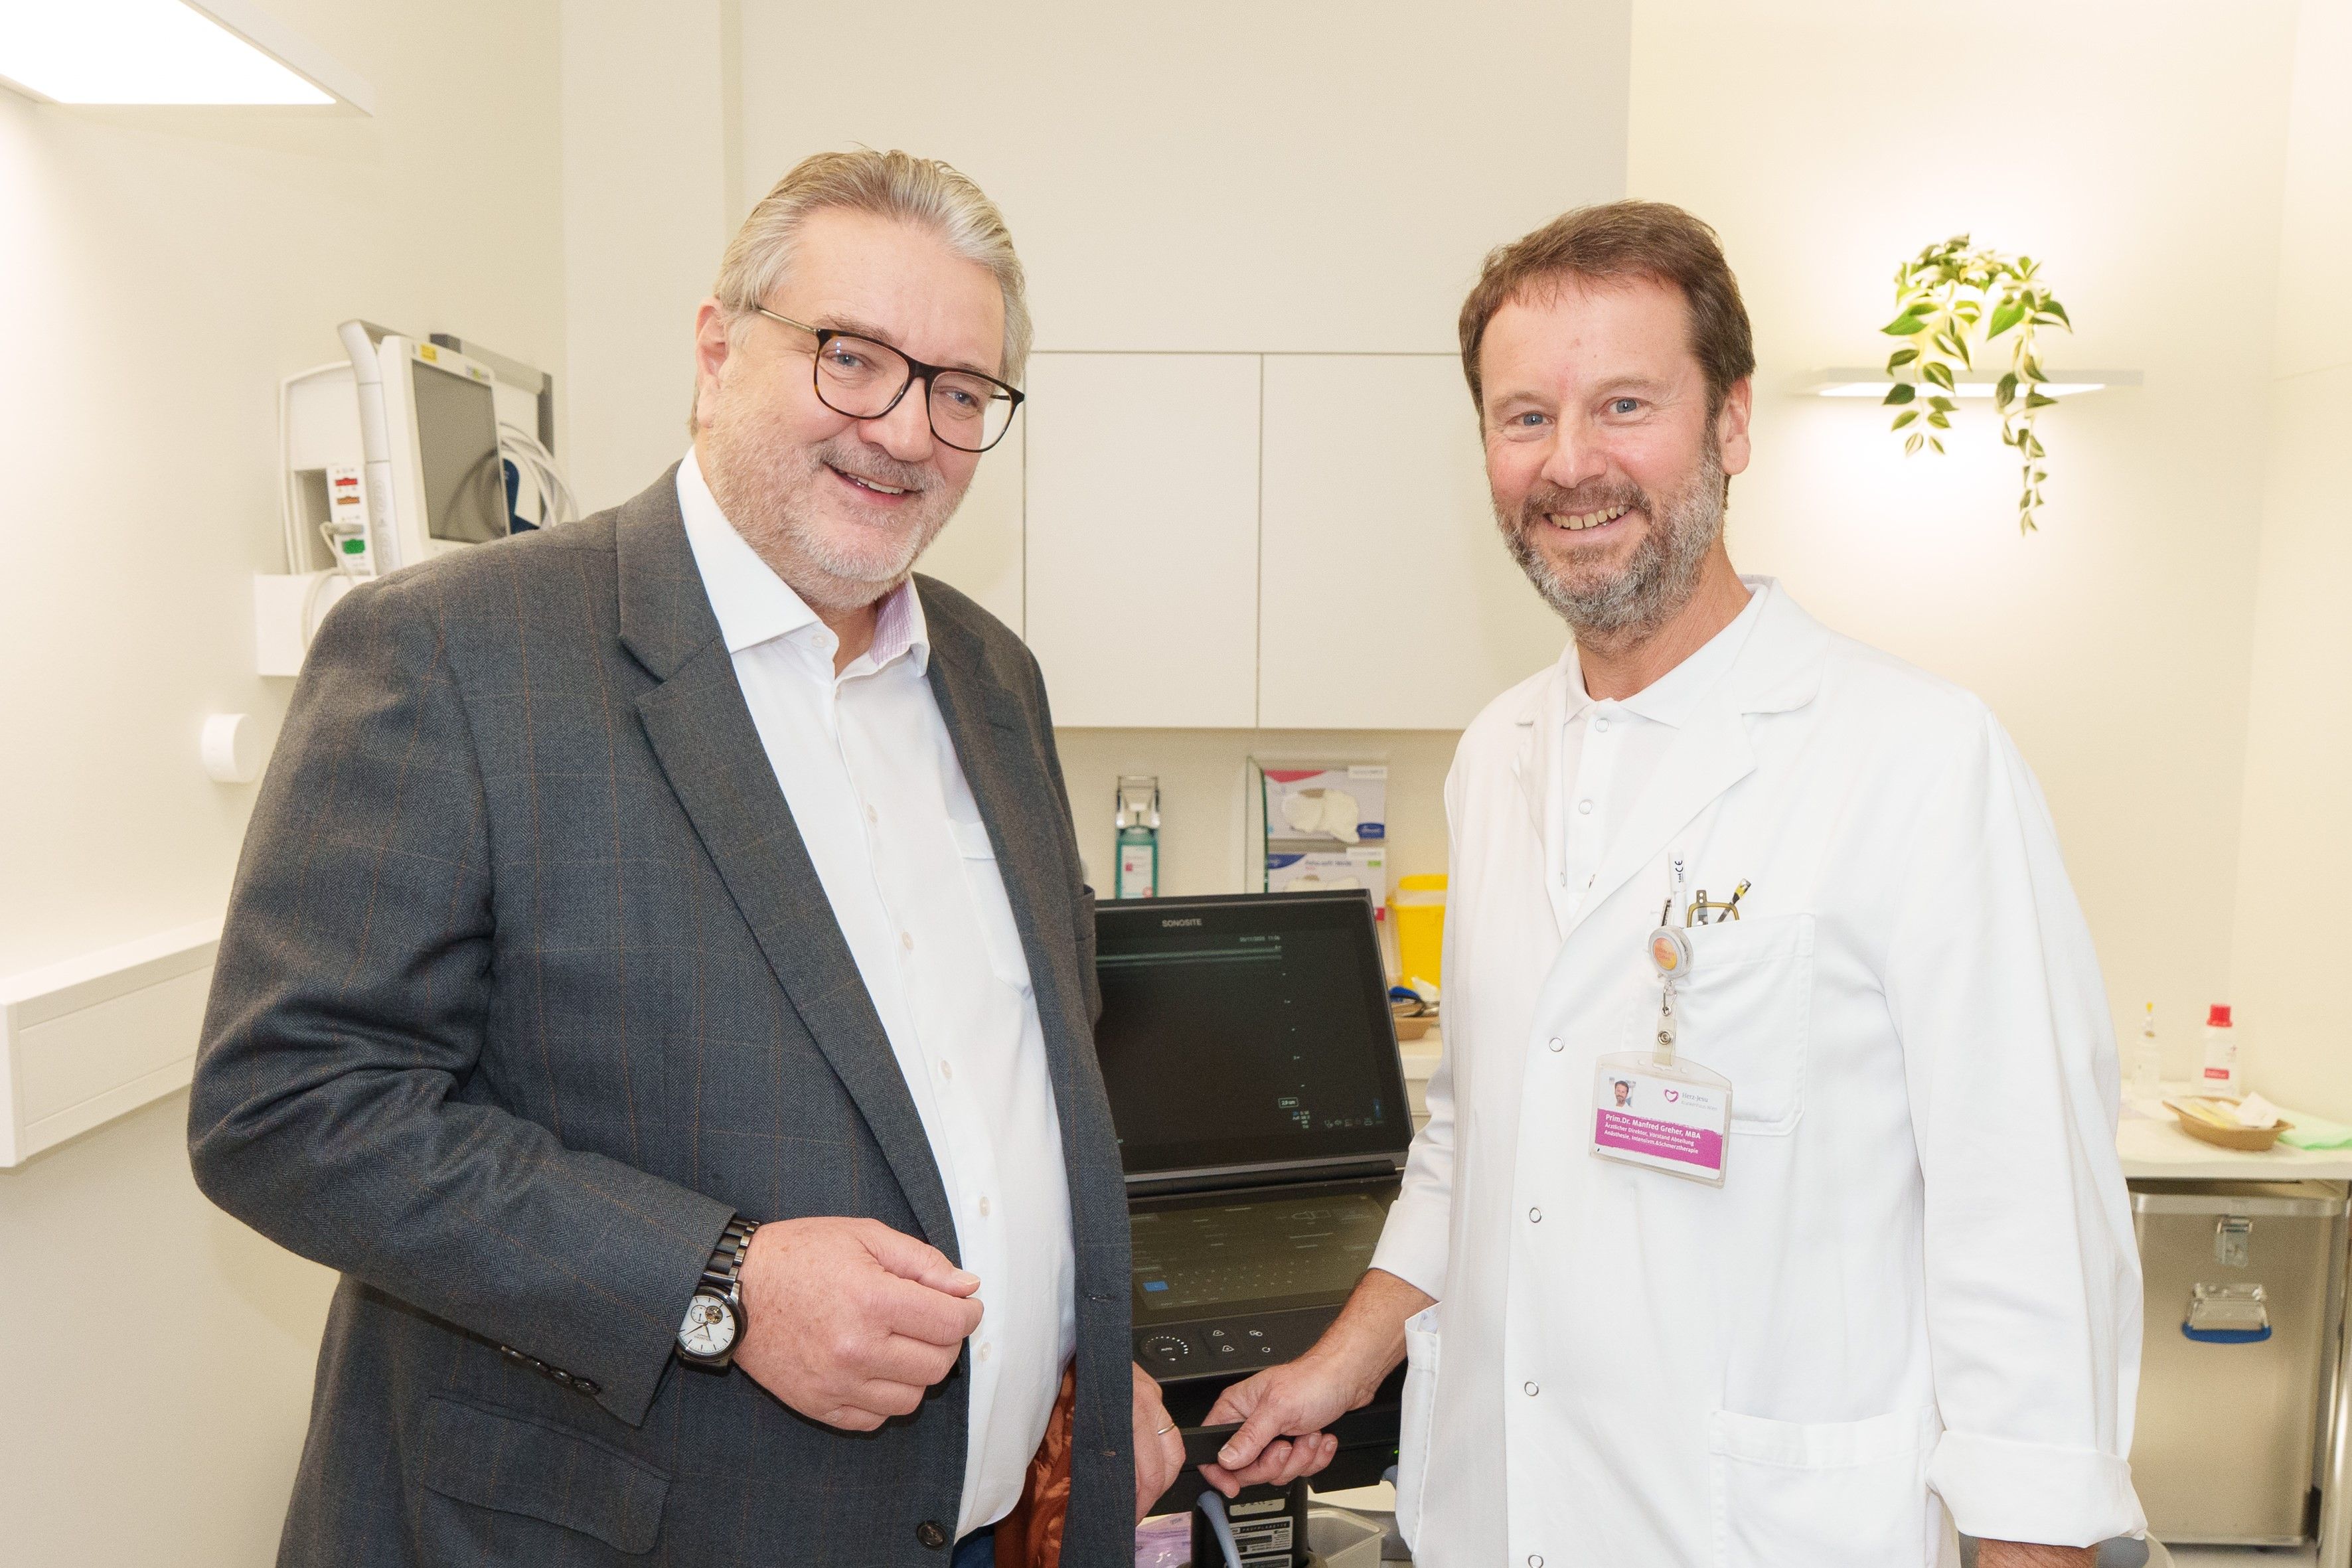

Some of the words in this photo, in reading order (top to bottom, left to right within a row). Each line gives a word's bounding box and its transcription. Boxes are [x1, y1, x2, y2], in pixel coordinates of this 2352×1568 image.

[1162, 918, 1202, 927] SONOSITE
[1682, 1092, 1709, 1103] Herz-Jesu
[1605, 1114, 1631, 1125] Prim.Dr.
[1632, 1119, 1662, 1131] Manfred
[1660, 1125, 1684, 1137] Greher,
[1685, 1130, 1701, 1139] MBA
[1604, 1130, 1631, 1140] Anästhesie,
[1605, 1123, 1628, 1133] Ärztlicher
[1628, 1127, 1648, 1137] Direktor,
[1649, 1131, 1670, 1140] Vorstand
[1671, 1136, 1695, 1146] Abteilung
